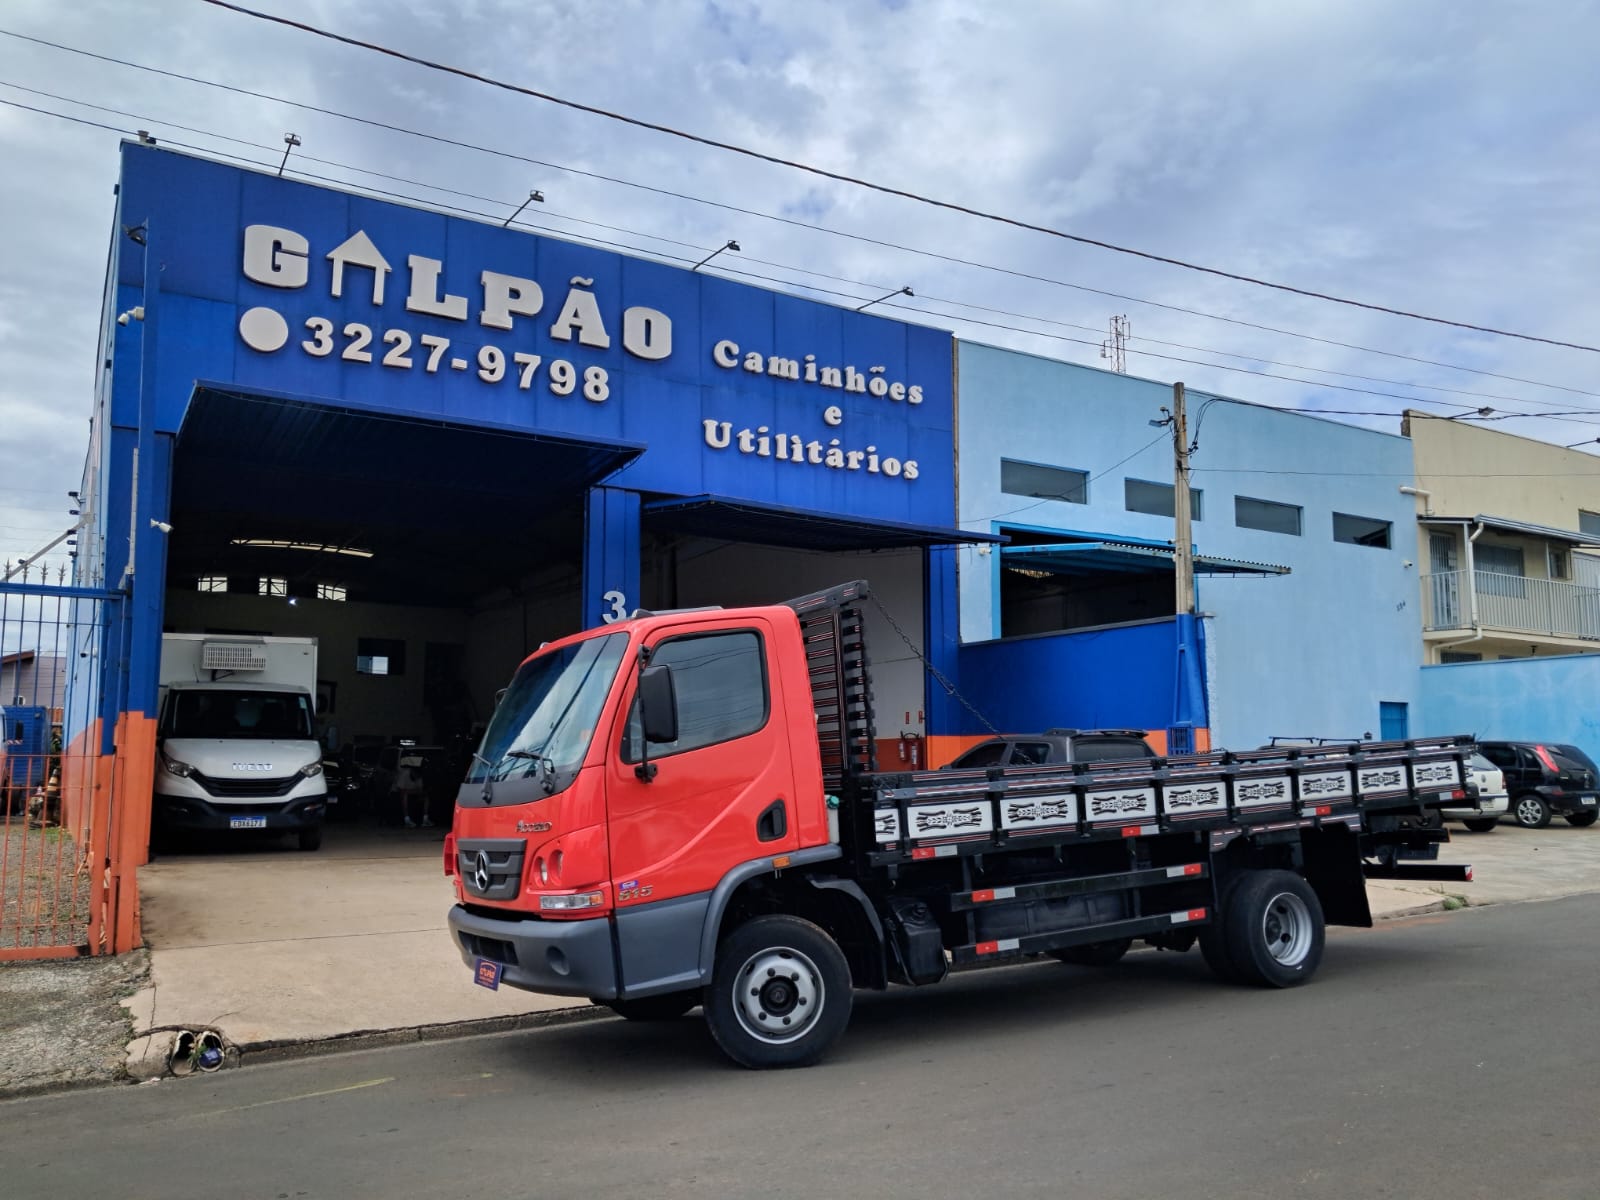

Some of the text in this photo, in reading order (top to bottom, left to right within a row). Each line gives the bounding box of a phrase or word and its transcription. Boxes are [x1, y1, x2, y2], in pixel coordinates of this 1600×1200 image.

[302, 316, 610, 403] 3227-9798
[713, 340, 924, 405] Caminhões
[824, 405, 843, 426] e
[703, 419, 919, 480] Utilitários
[602, 591, 626, 624] 3
